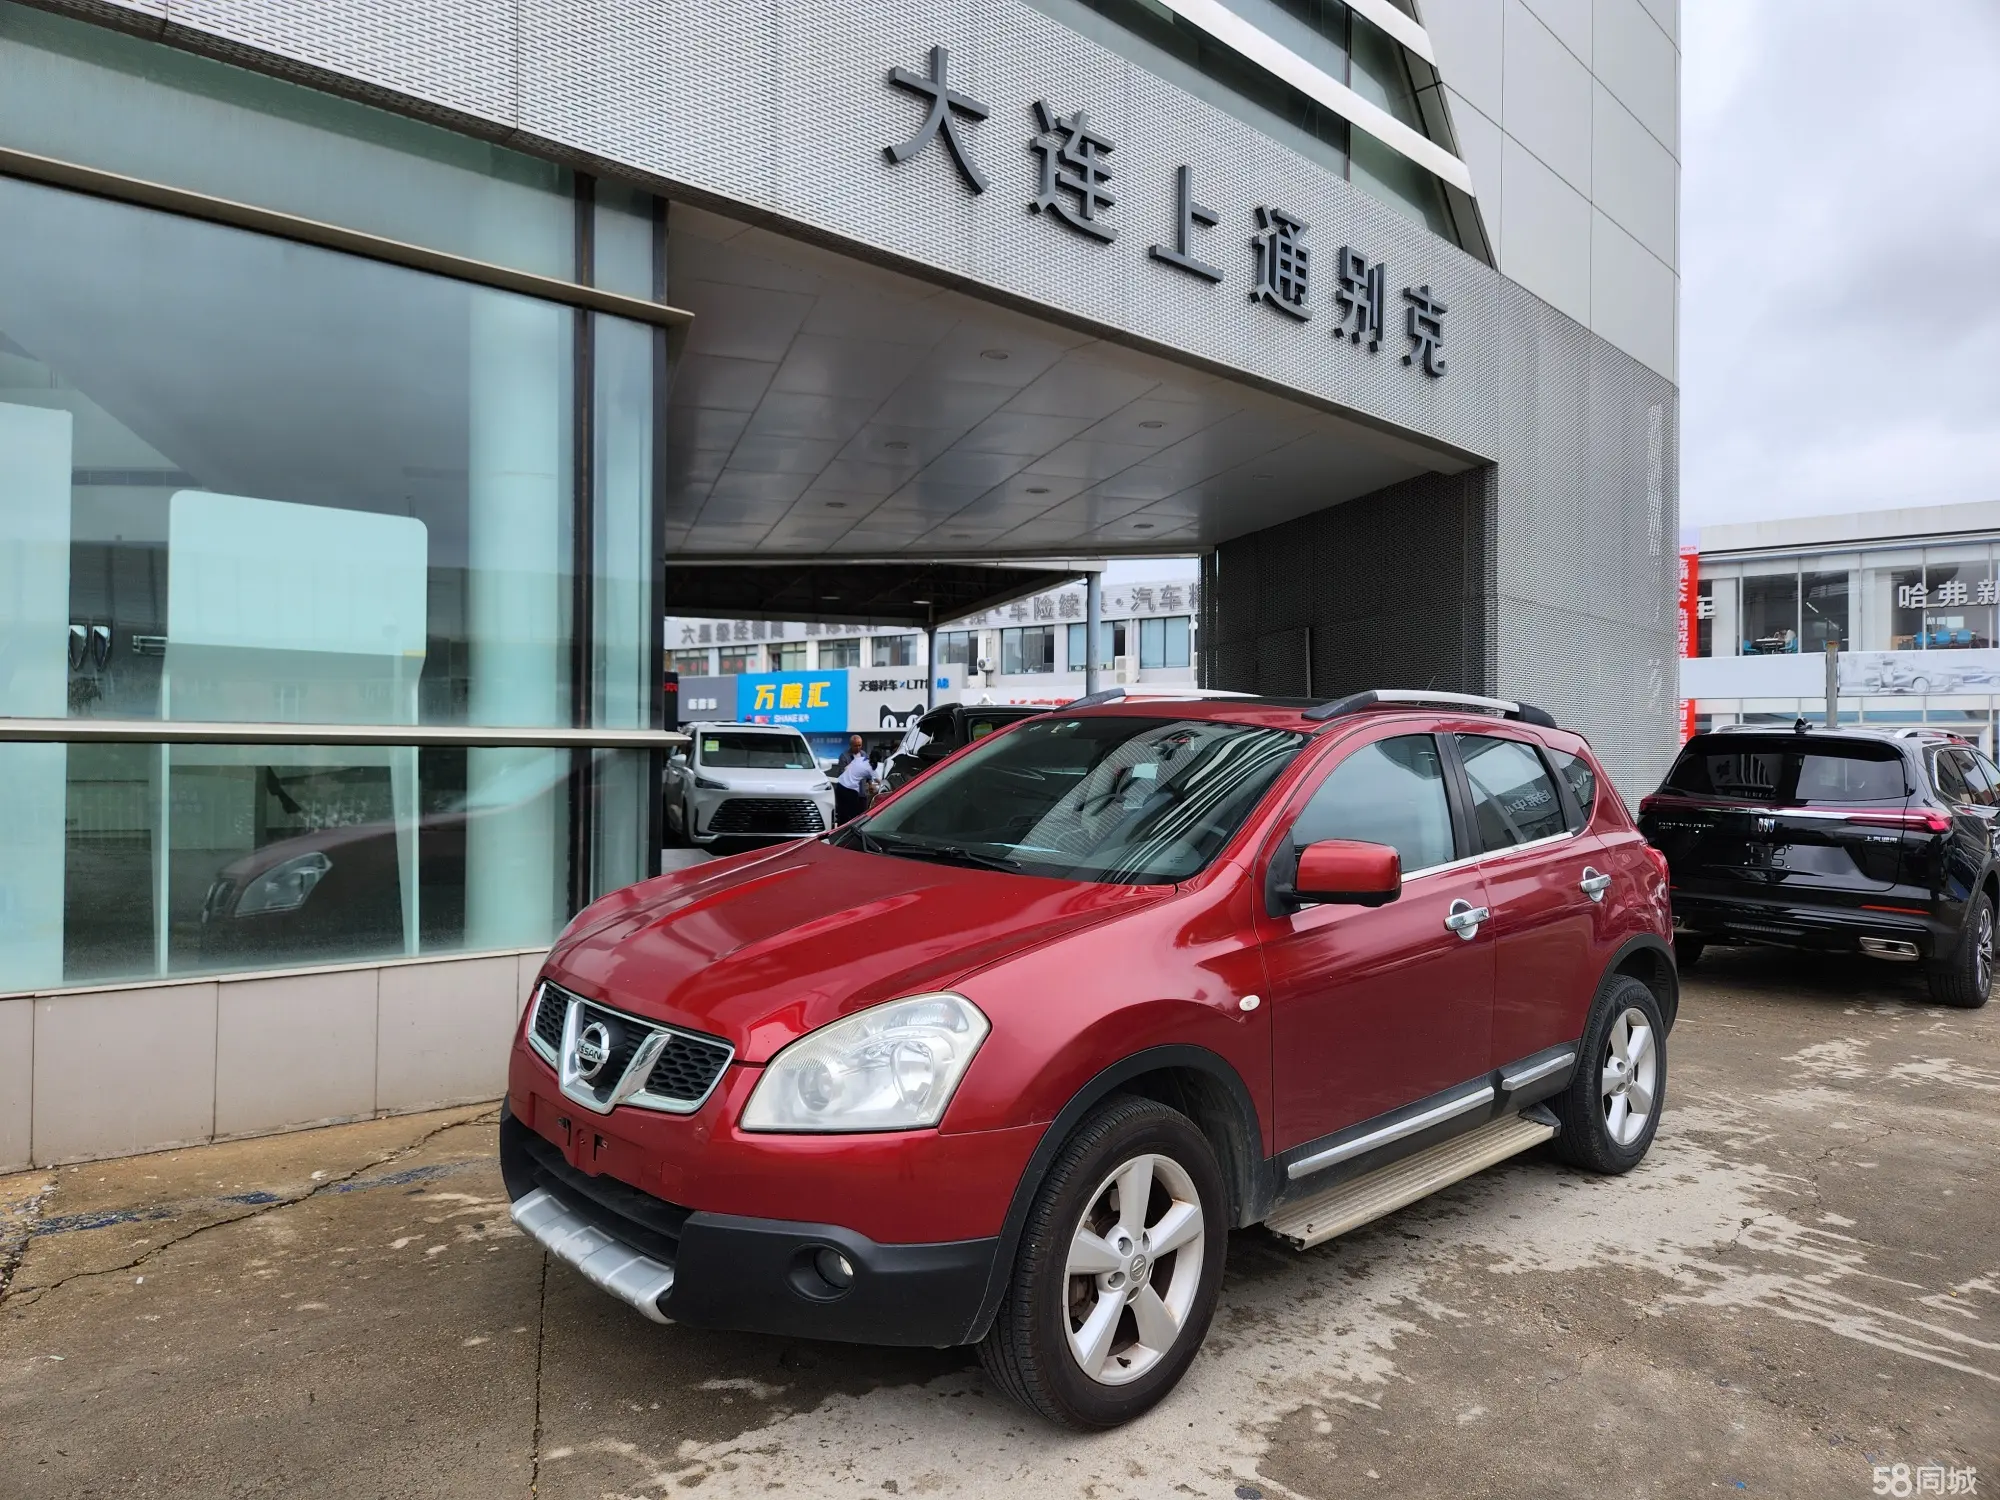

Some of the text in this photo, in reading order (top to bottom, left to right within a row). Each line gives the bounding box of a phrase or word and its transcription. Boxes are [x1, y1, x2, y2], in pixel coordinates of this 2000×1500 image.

[883, 45, 1449, 377] 大连上通别克
